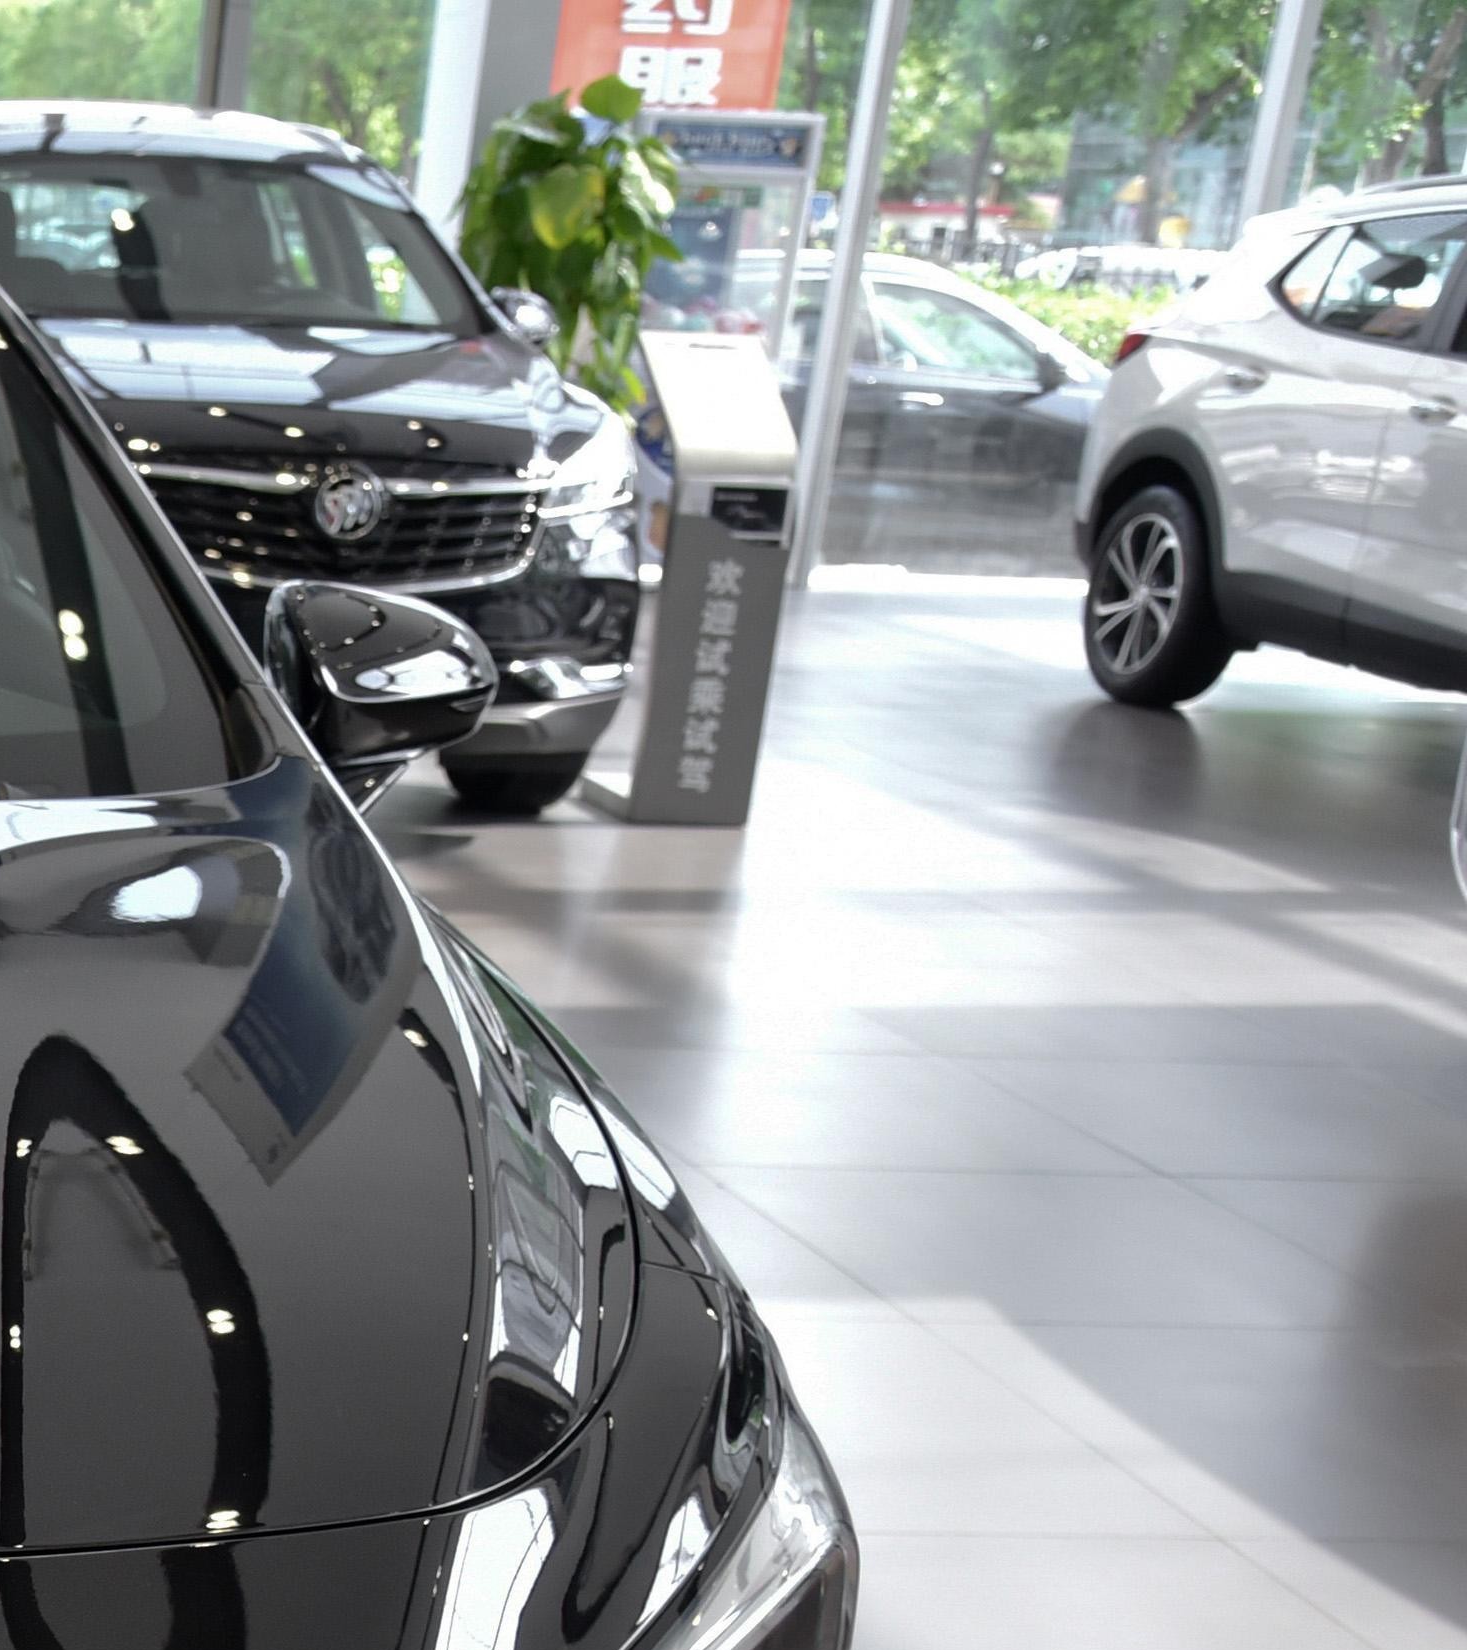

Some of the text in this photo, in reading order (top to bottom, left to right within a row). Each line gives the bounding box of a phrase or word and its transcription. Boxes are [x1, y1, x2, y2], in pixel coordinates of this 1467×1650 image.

[677, 556, 746, 793] 欢迎试乘试驾
